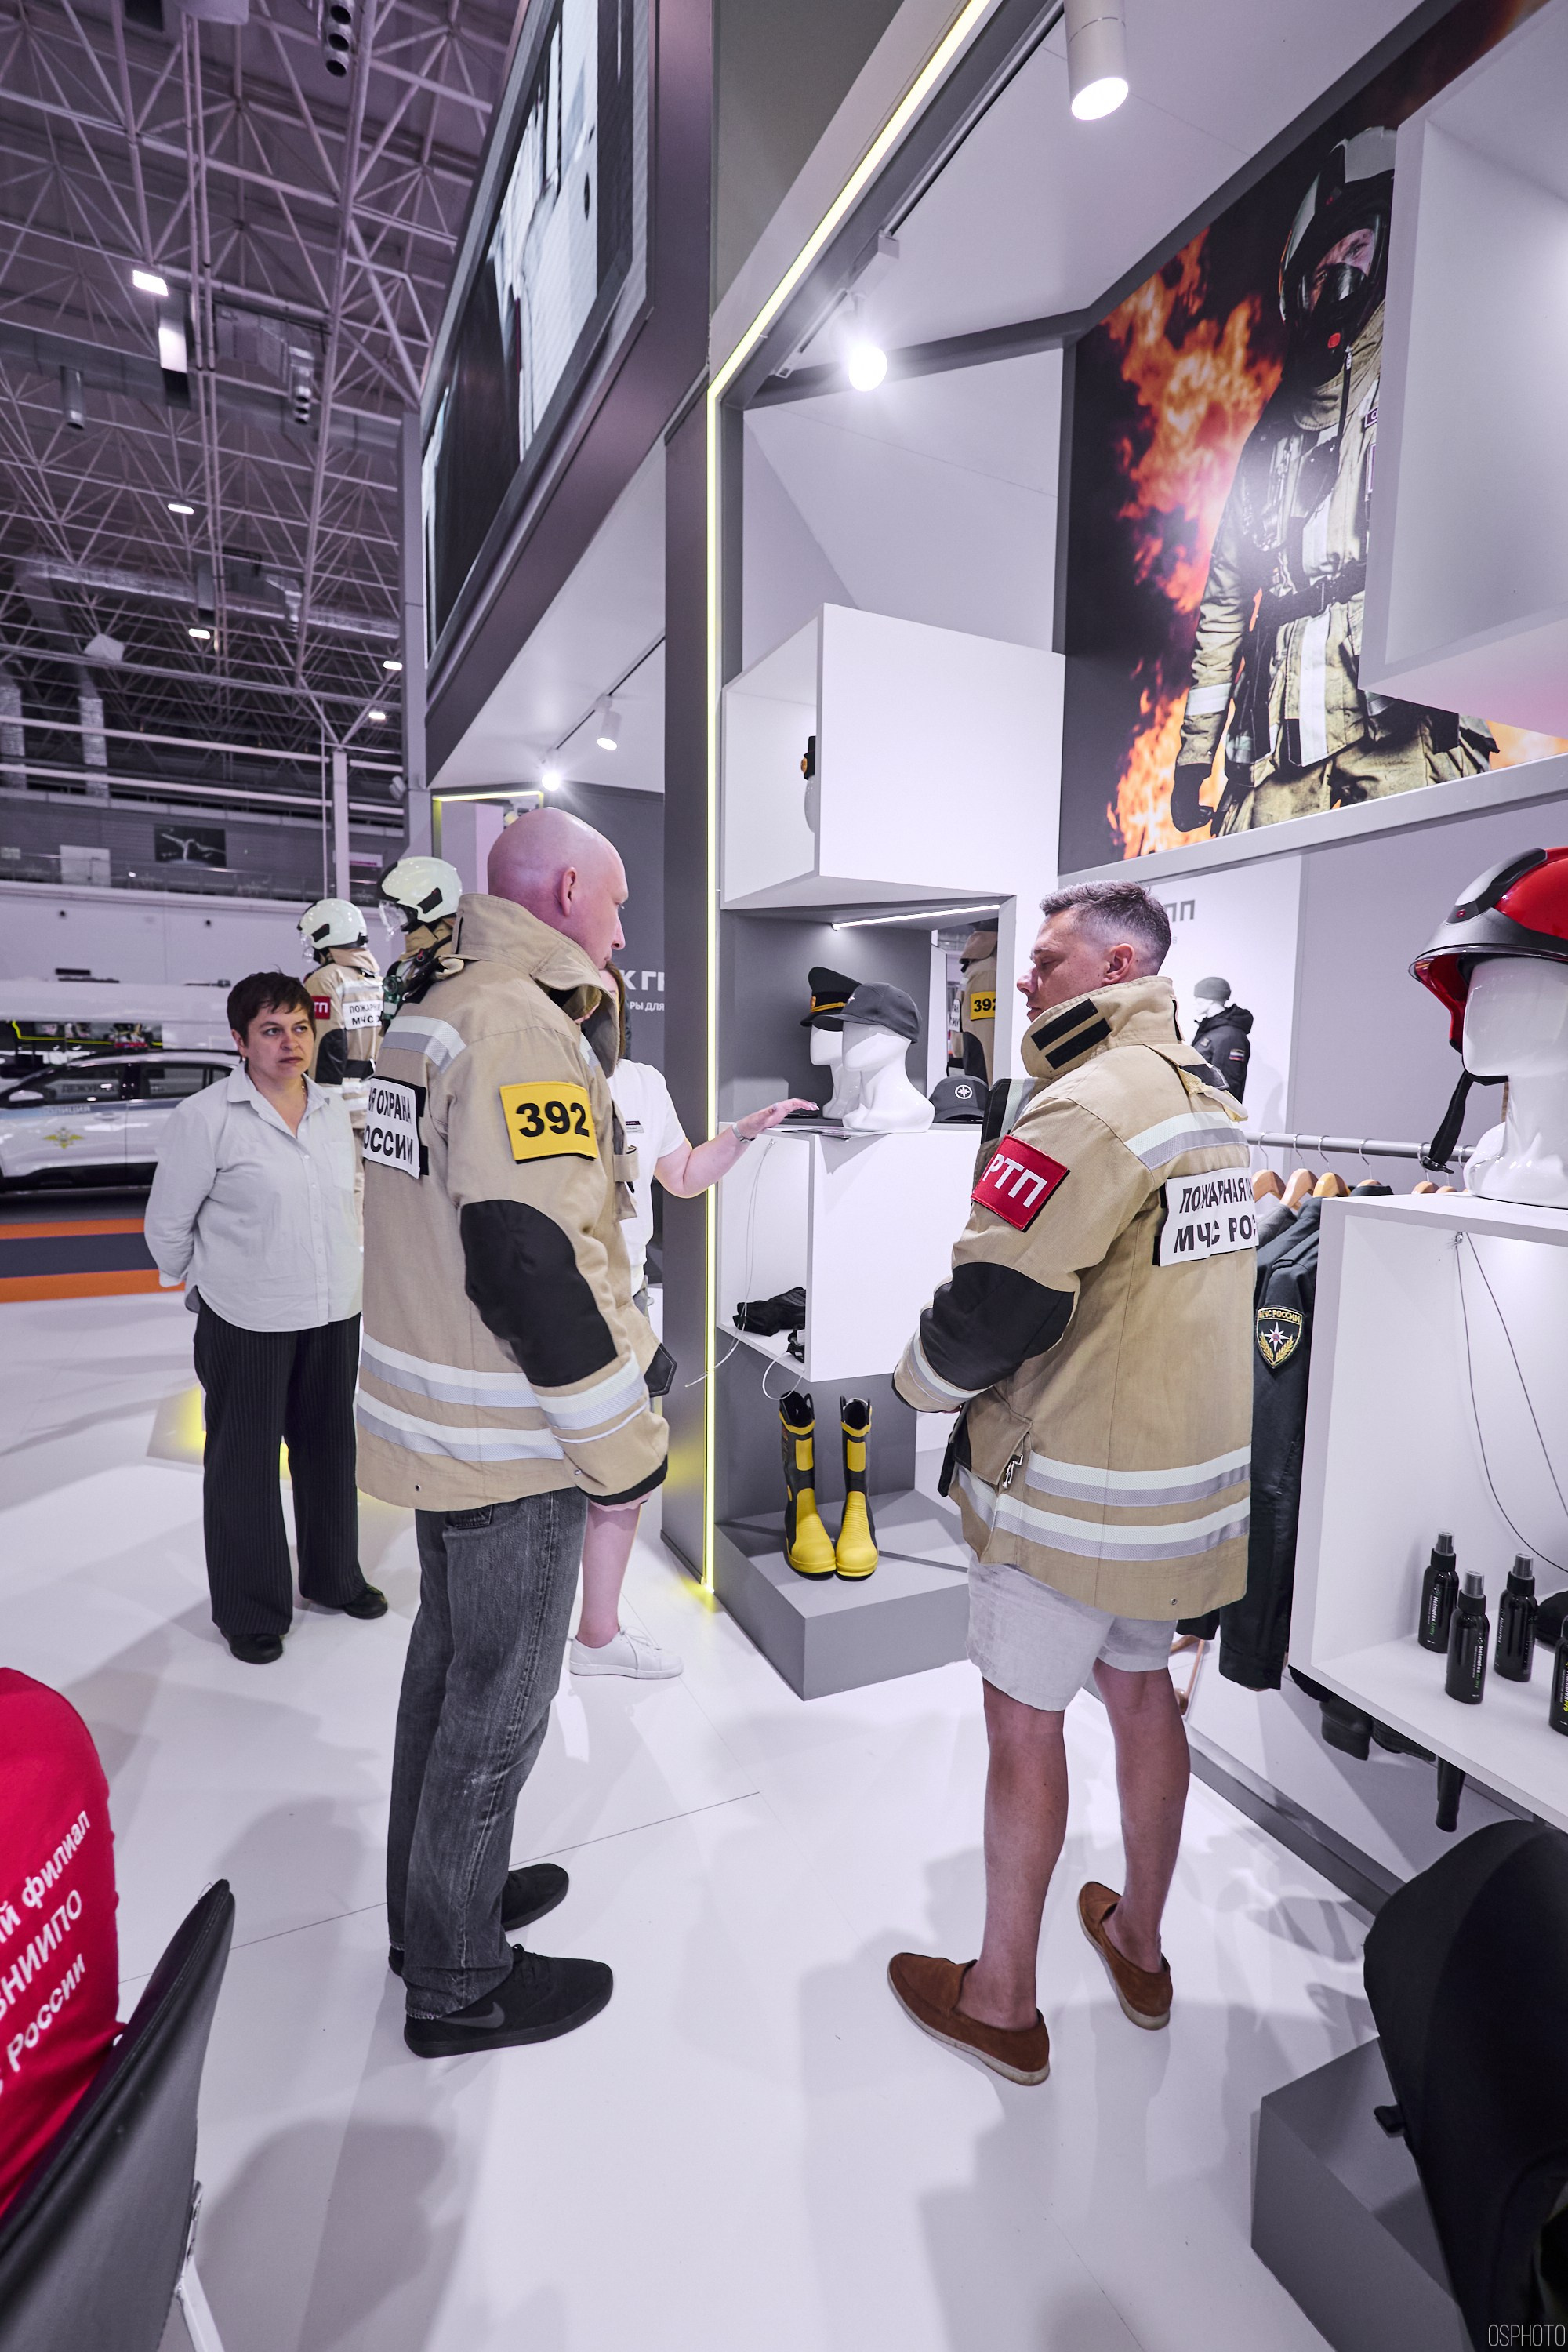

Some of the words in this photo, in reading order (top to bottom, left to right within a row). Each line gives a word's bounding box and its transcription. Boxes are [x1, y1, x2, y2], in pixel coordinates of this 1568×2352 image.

[644, 1002, 665, 1012] ДЛЯ
[377, 1090, 412, 1124] ОХРАНА
[516, 1100, 590, 1138] 392
[982, 1153, 1047, 1208] РТП
[1179, 1178, 1247, 1214] ПОЖАРНАЯ
[1174, 1220, 1221, 1254] МЧС
[1272, 1310, 1301, 1323] РОССИИ
[21, 1810, 90, 1909] филиал
[7, 1953, 85, 2072] России
